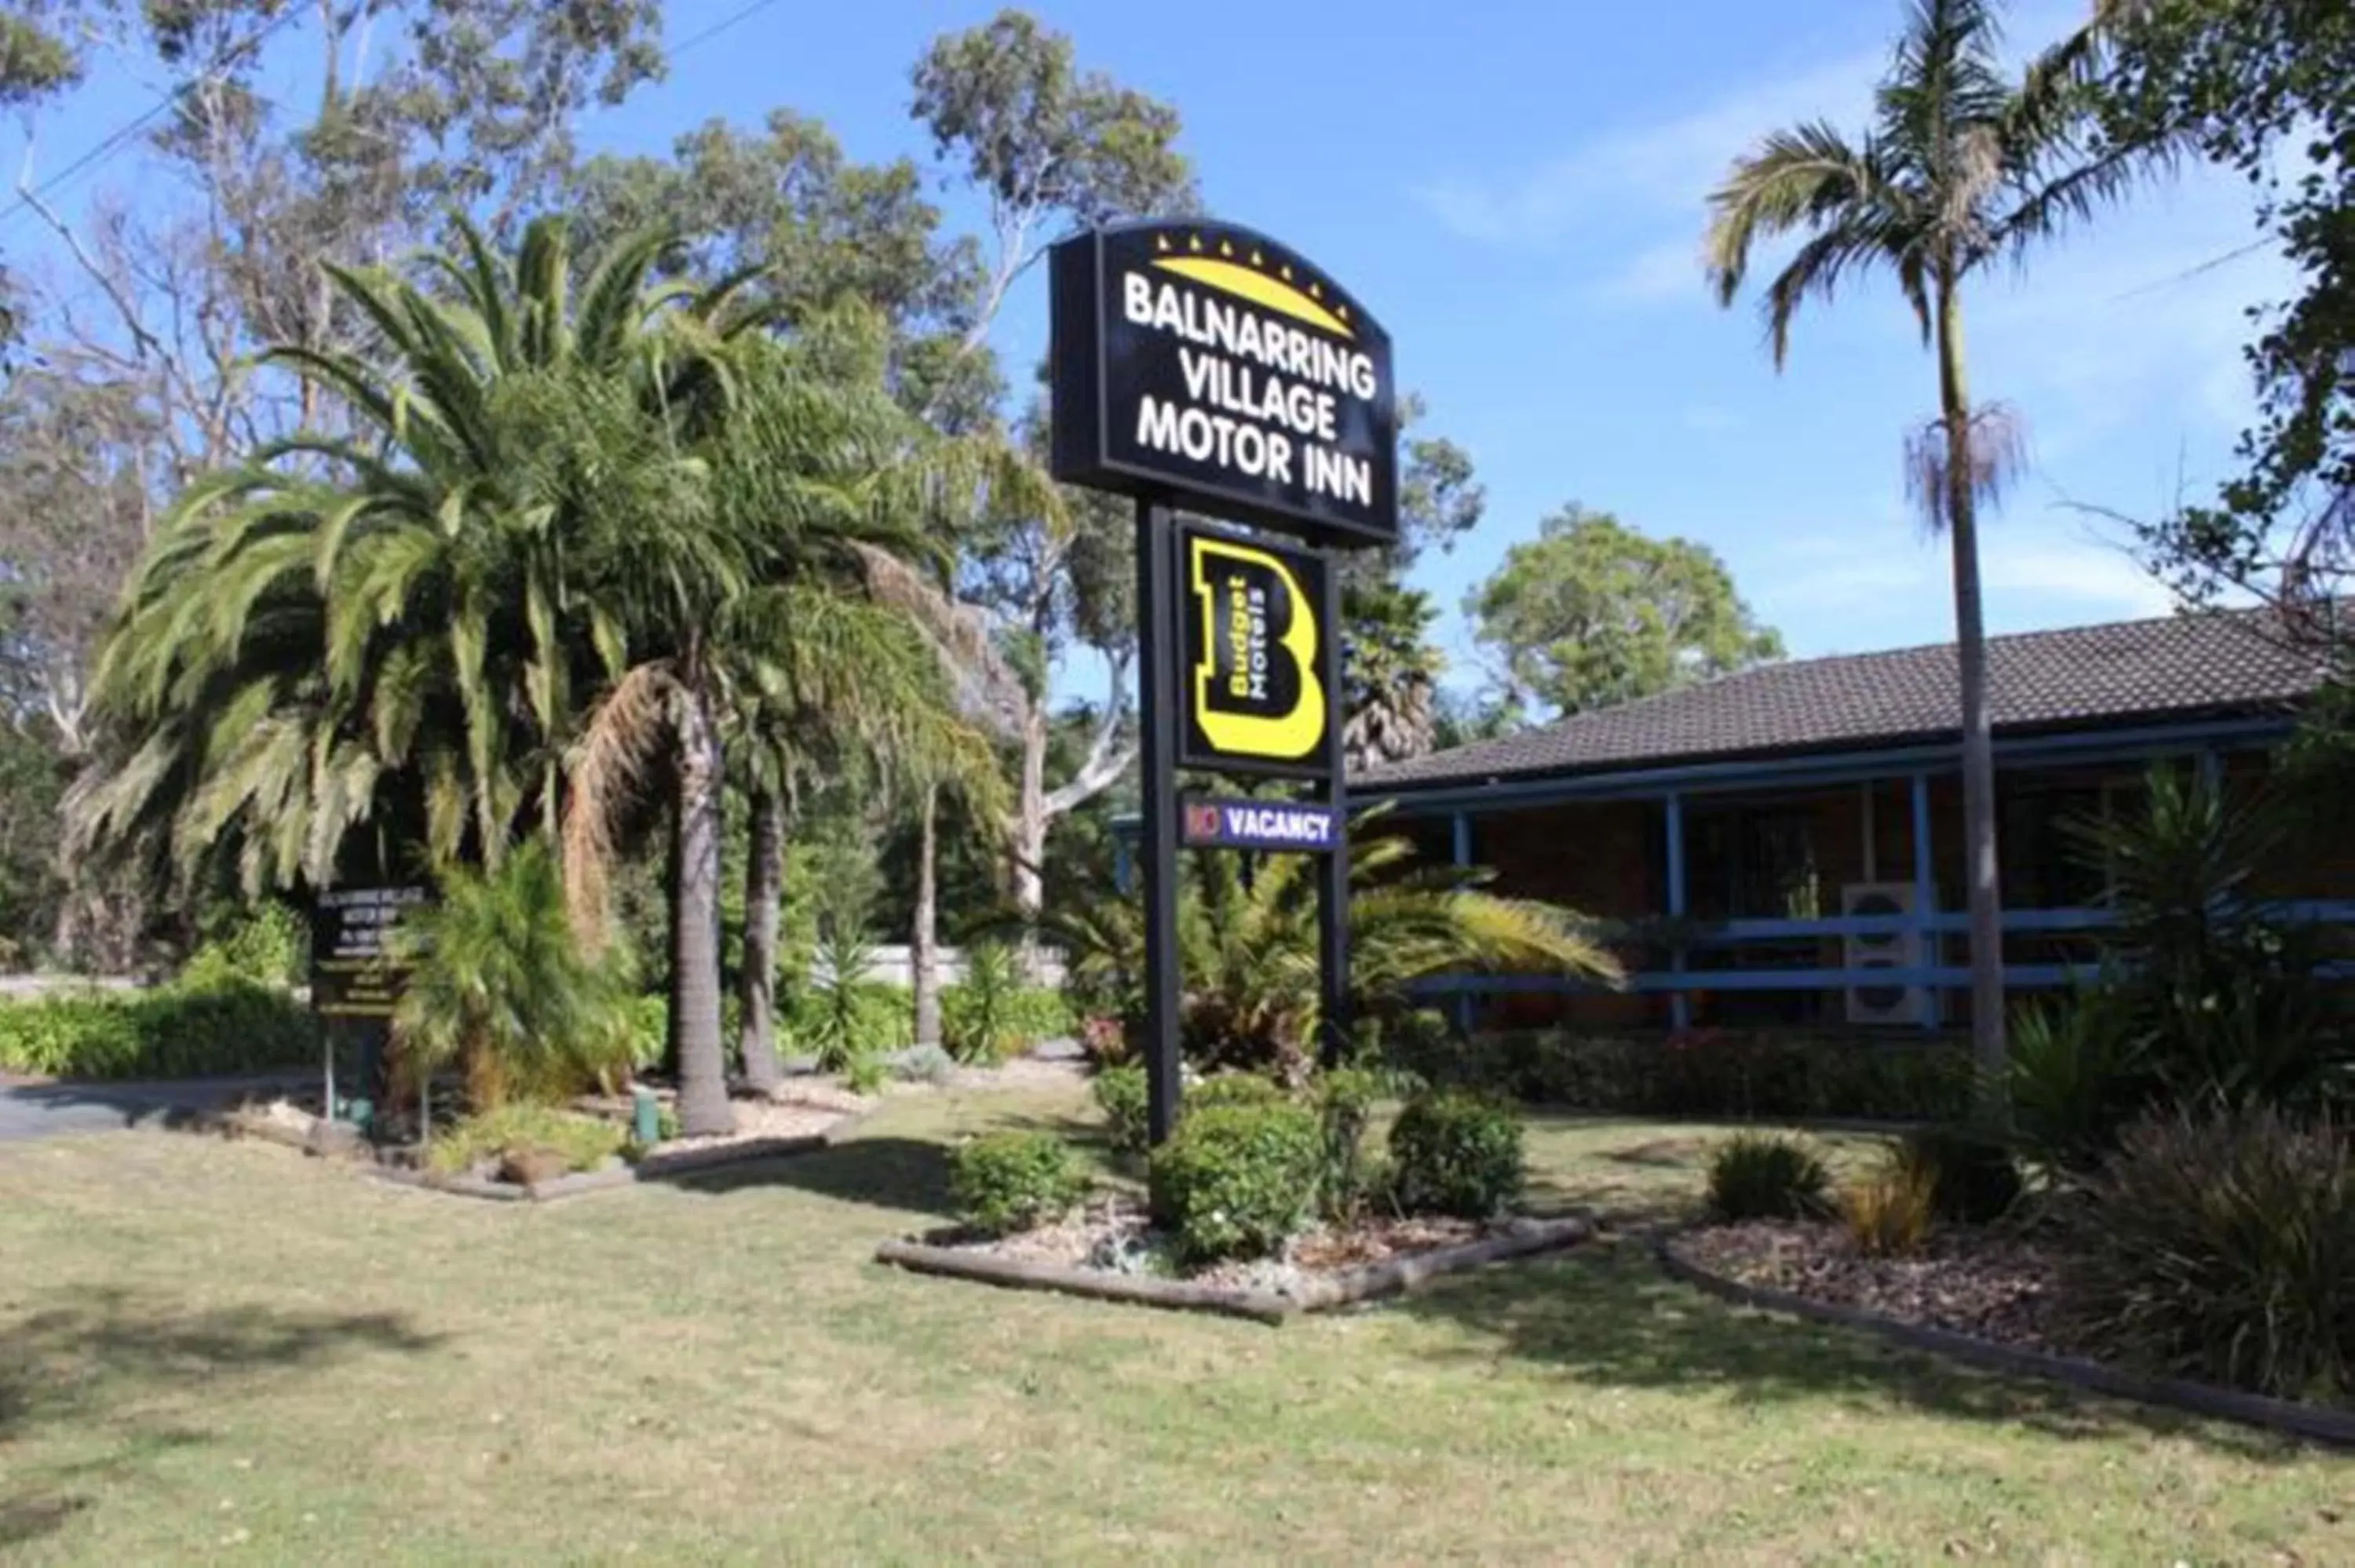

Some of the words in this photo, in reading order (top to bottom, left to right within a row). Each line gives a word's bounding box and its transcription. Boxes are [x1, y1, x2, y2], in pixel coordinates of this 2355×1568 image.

[1124, 272, 1376, 400] BALNARRING
[1179, 348, 1336, 440] VILLAGE
[1136, 395, 1292, 483] MOTOR
[1304, 445, 1371, 506] INN
[1228, 574, 1249, 698] Budget
[1248, 588, 1269, 700] Motels
[1226, 807, 1331, 842] VACANCY
